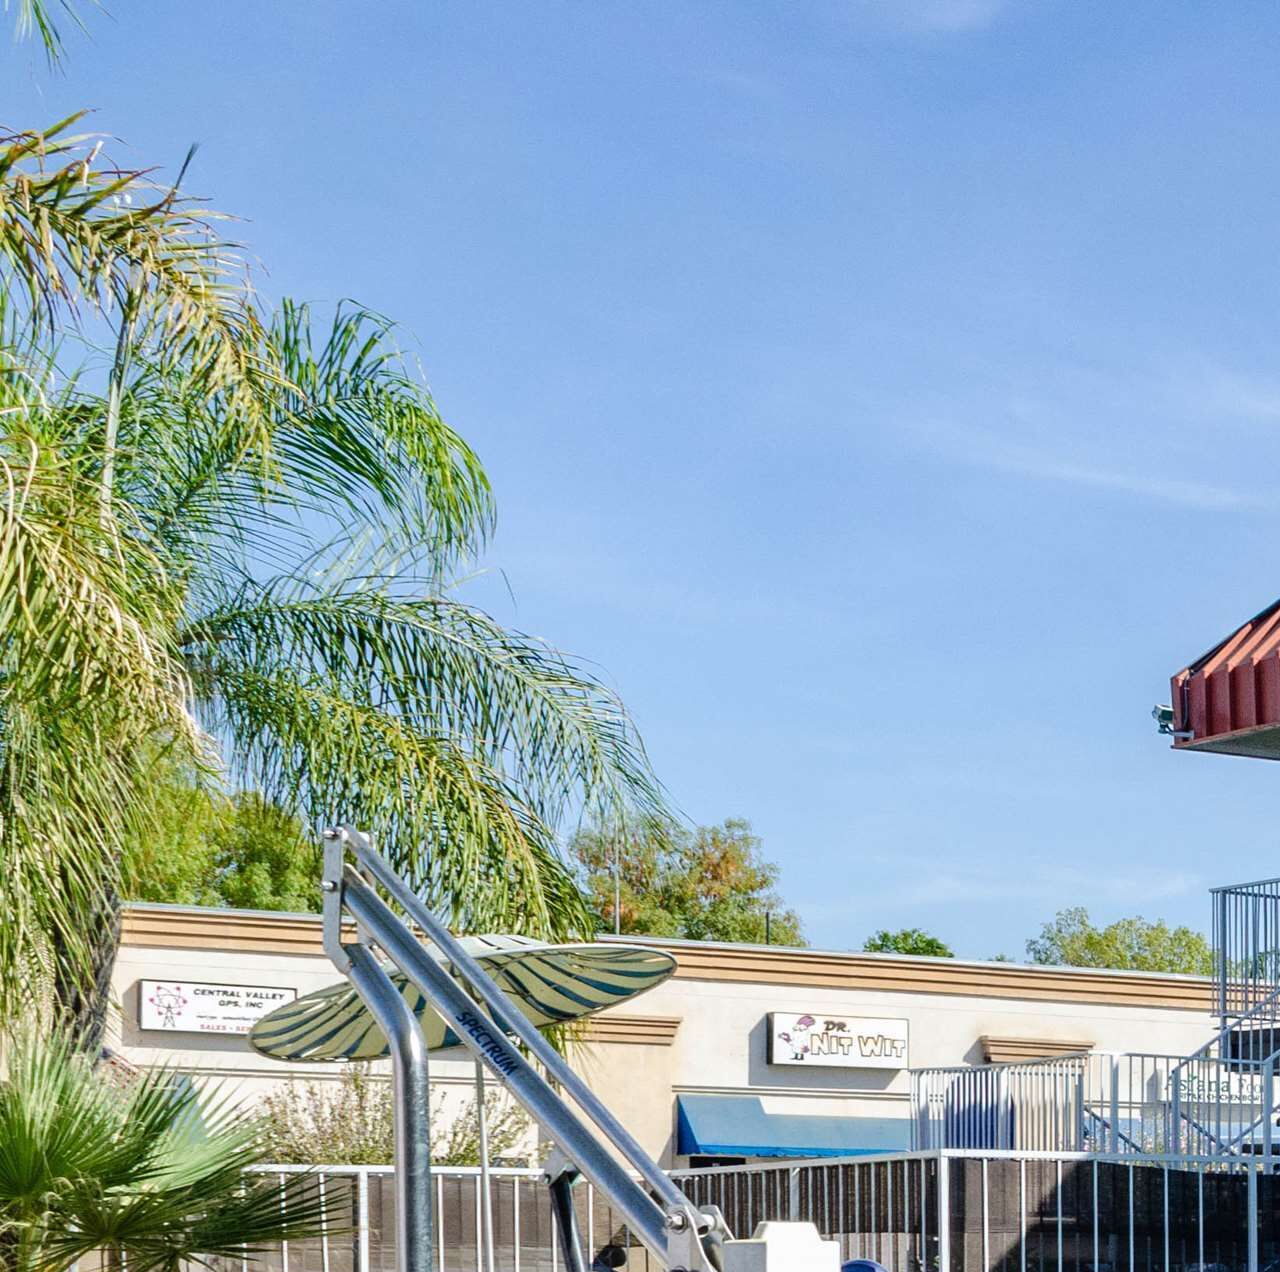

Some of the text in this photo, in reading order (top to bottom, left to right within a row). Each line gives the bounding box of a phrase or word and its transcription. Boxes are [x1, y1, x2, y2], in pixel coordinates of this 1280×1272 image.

[193, 988, 285, 1000] CENTRAL VALLEY
[246, 1001, 263, 1009] INC
[823, 1020, 850, 1032] DR.
[456, 1012, 518, 1076] SPECTRUM
